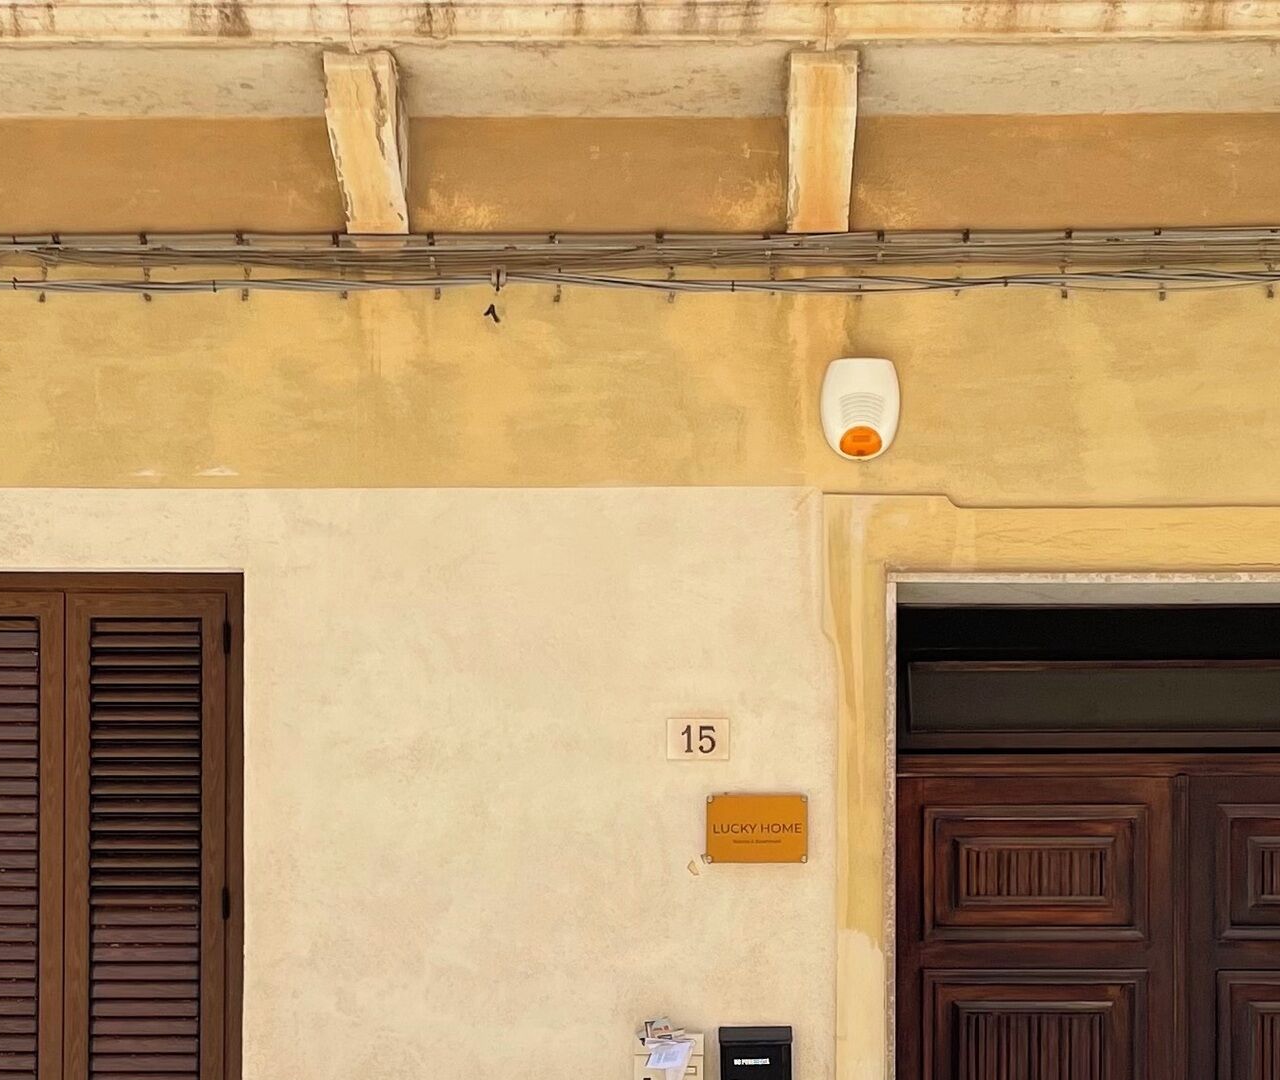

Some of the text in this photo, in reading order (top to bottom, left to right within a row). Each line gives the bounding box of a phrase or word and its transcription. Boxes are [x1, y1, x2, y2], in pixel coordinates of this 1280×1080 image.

[681, 724, 717, 754] 15
[712, 822, 802, 834] LUCKY HOME
